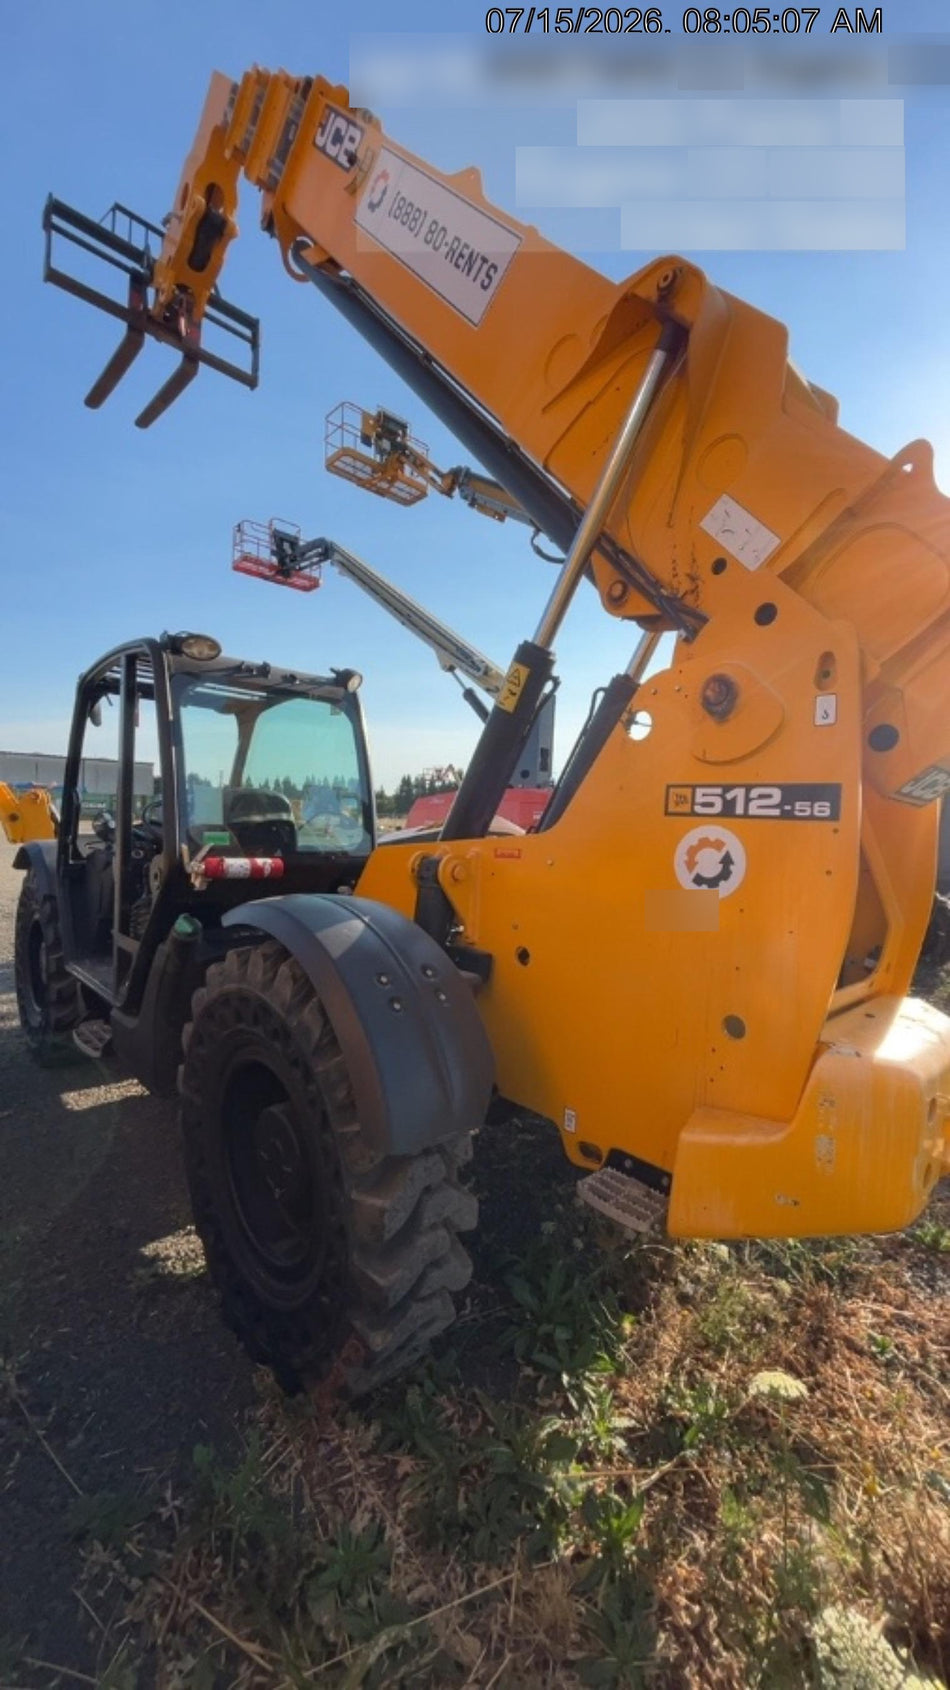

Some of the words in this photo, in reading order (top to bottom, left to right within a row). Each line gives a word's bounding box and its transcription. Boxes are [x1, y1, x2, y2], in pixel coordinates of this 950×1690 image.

[314, 111, 362, 169] JCB
[388, 190, 428, 238] (888)
[423, 219, 499, 292] 80-RENTS
[693, 786, 831, 817] 512-56
